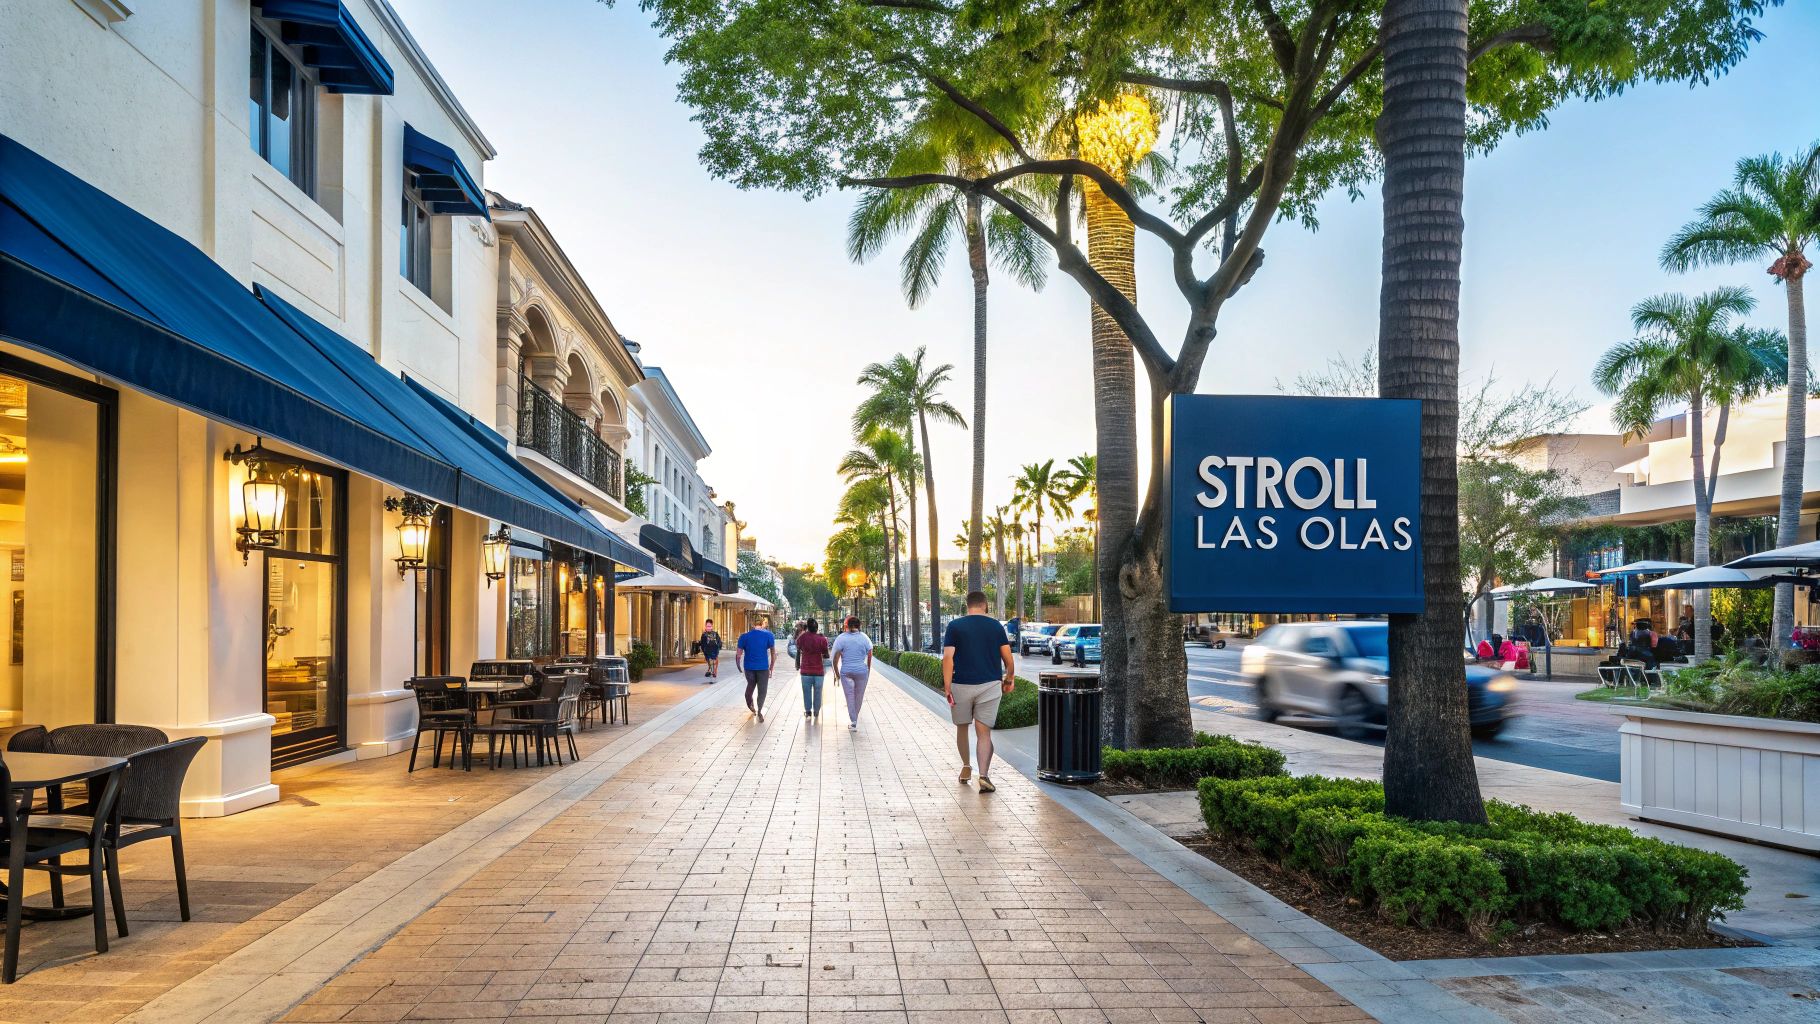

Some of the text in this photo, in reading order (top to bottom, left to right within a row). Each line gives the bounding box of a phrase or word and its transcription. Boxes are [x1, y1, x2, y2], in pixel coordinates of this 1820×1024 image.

[1196, 455, 1377, 510] STROLL
[1197, 515, 1412, 551] LAS OLAS
